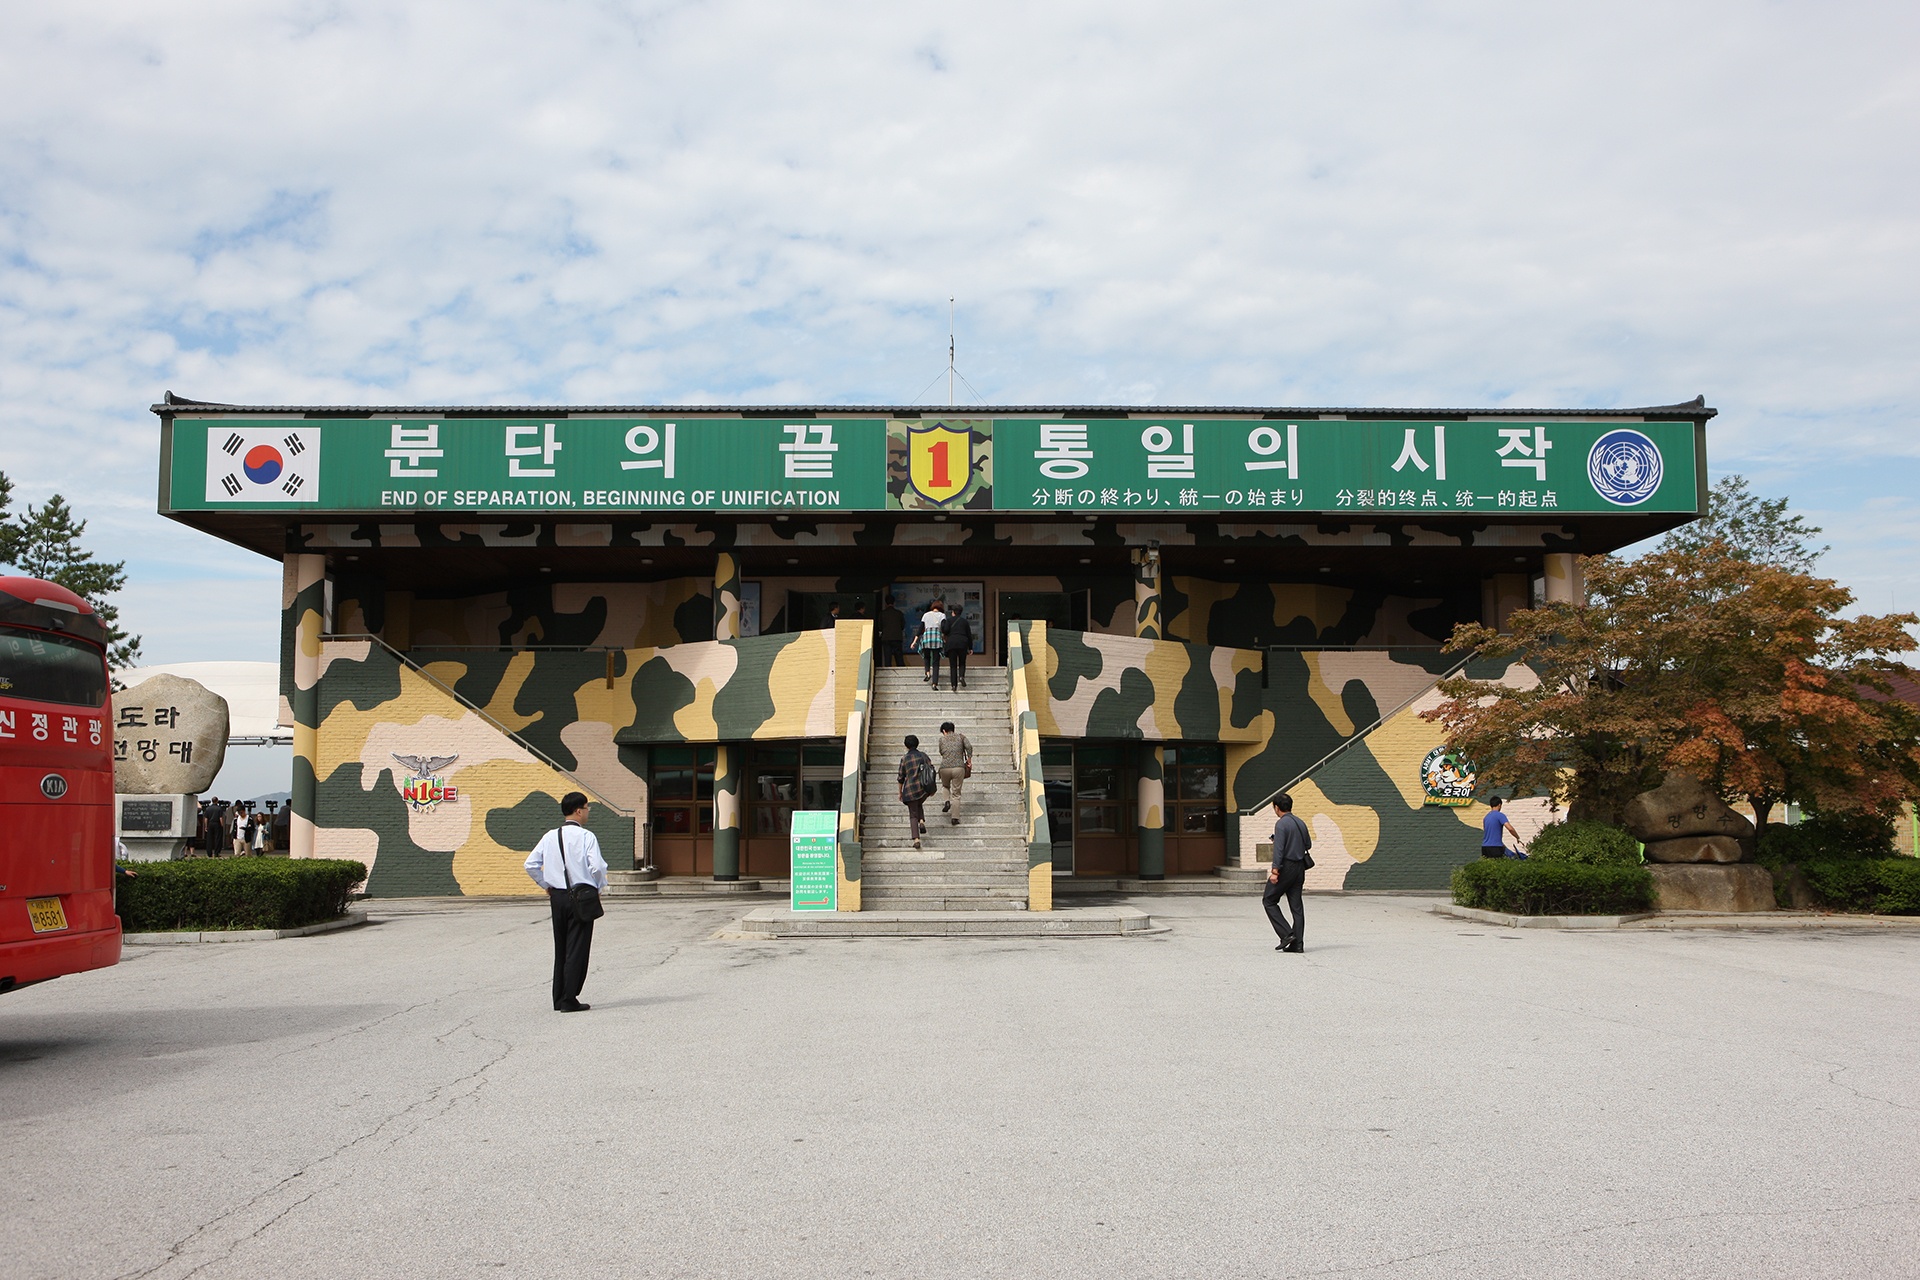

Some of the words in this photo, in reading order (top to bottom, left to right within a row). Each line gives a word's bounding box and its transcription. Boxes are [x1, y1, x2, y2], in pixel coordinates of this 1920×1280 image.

[778, 424, 839, 478] 끝
[927, 441, 952, 488] 1
[381, 491, 418, 506] END
[423, 490, 448, 506] OF
[453, 490, 577, 508] SEPARATION,
[583, 490, 685, 506] BEGINNING
[691, 490, 716, 506] OF
[721, 490, 840, 506] UNIFICATION
[117, 706, 181, 729] 도라
[46, 779, 65, 793] KIA
[1441, 787, 1471, 797] 호국이
[1425, 796, 1474, 806] Hogugy
